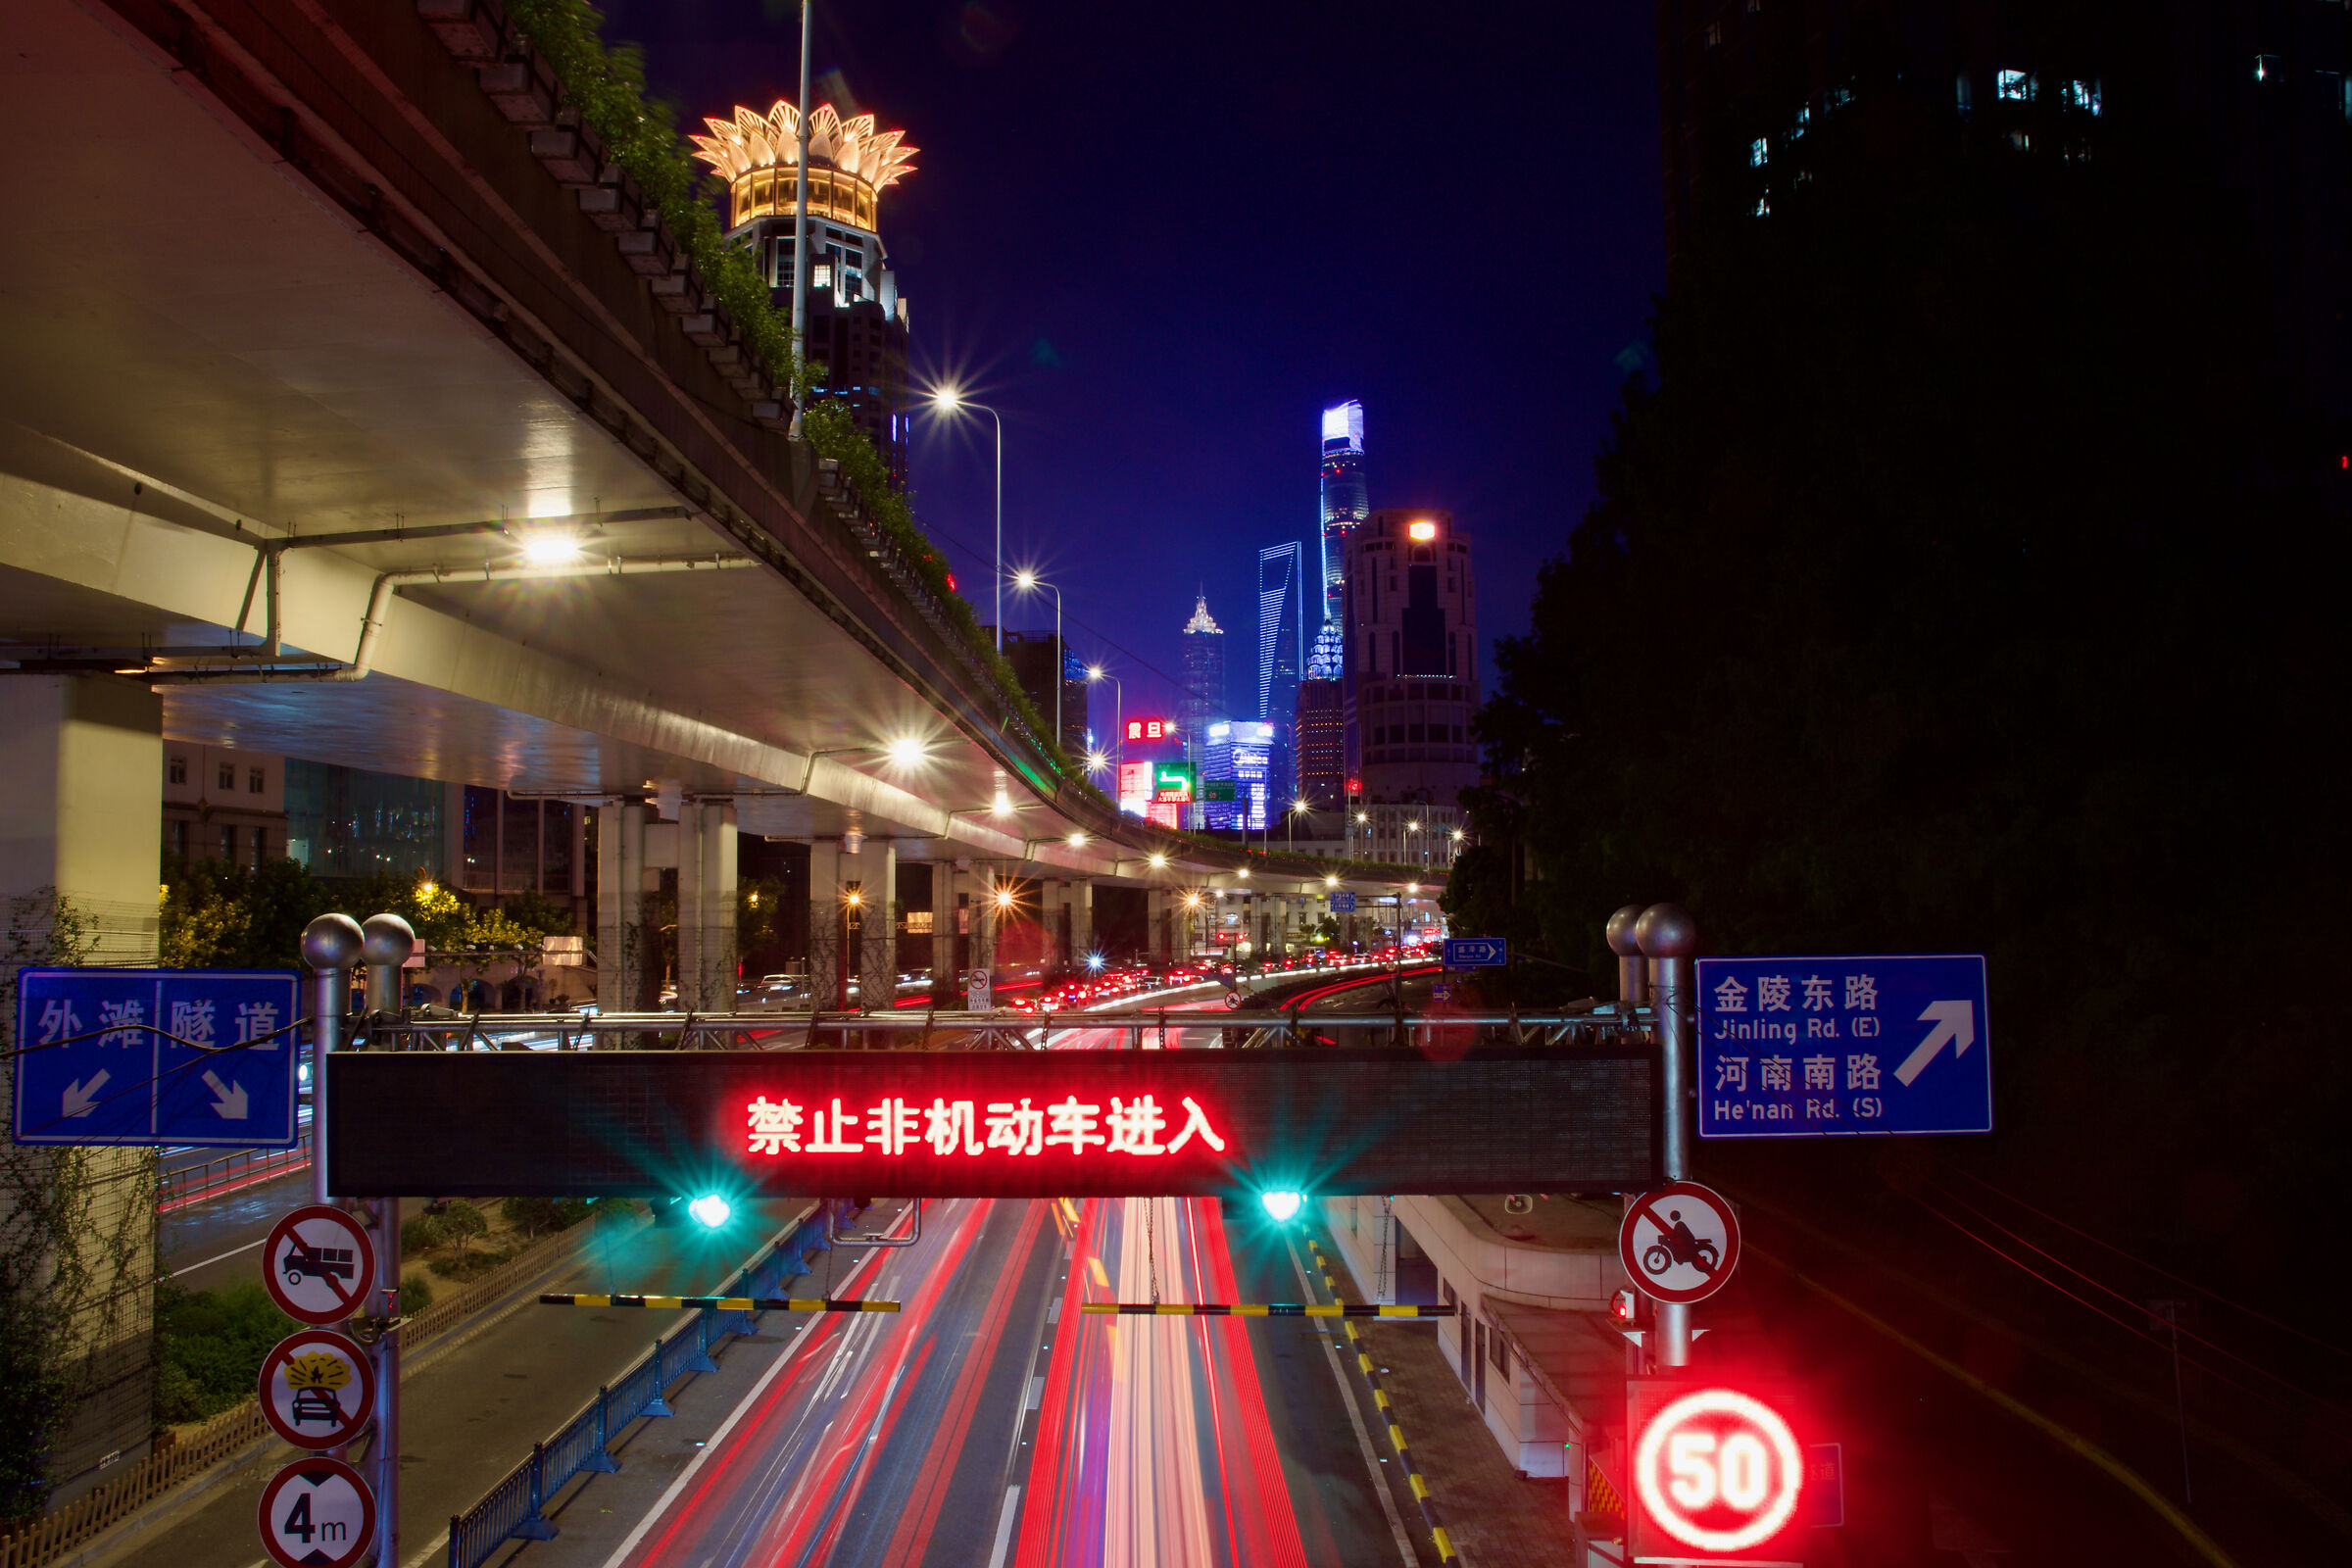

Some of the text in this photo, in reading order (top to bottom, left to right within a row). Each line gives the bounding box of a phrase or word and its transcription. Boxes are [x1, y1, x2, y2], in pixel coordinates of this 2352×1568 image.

[1714, 974, 1878, 1013] 金陵东路
[1714, 1016, 1881, 1046] Jinling Rd. (E)
[1714, 1054, 1882, 1092] 河南南路
[748, 1094, 1225, 1155] 禁止非机动车进入
[1714, 1097, 1883, 1121] He'nan Rd. (S)
[1670, 1434, 1768, 1510] 50
